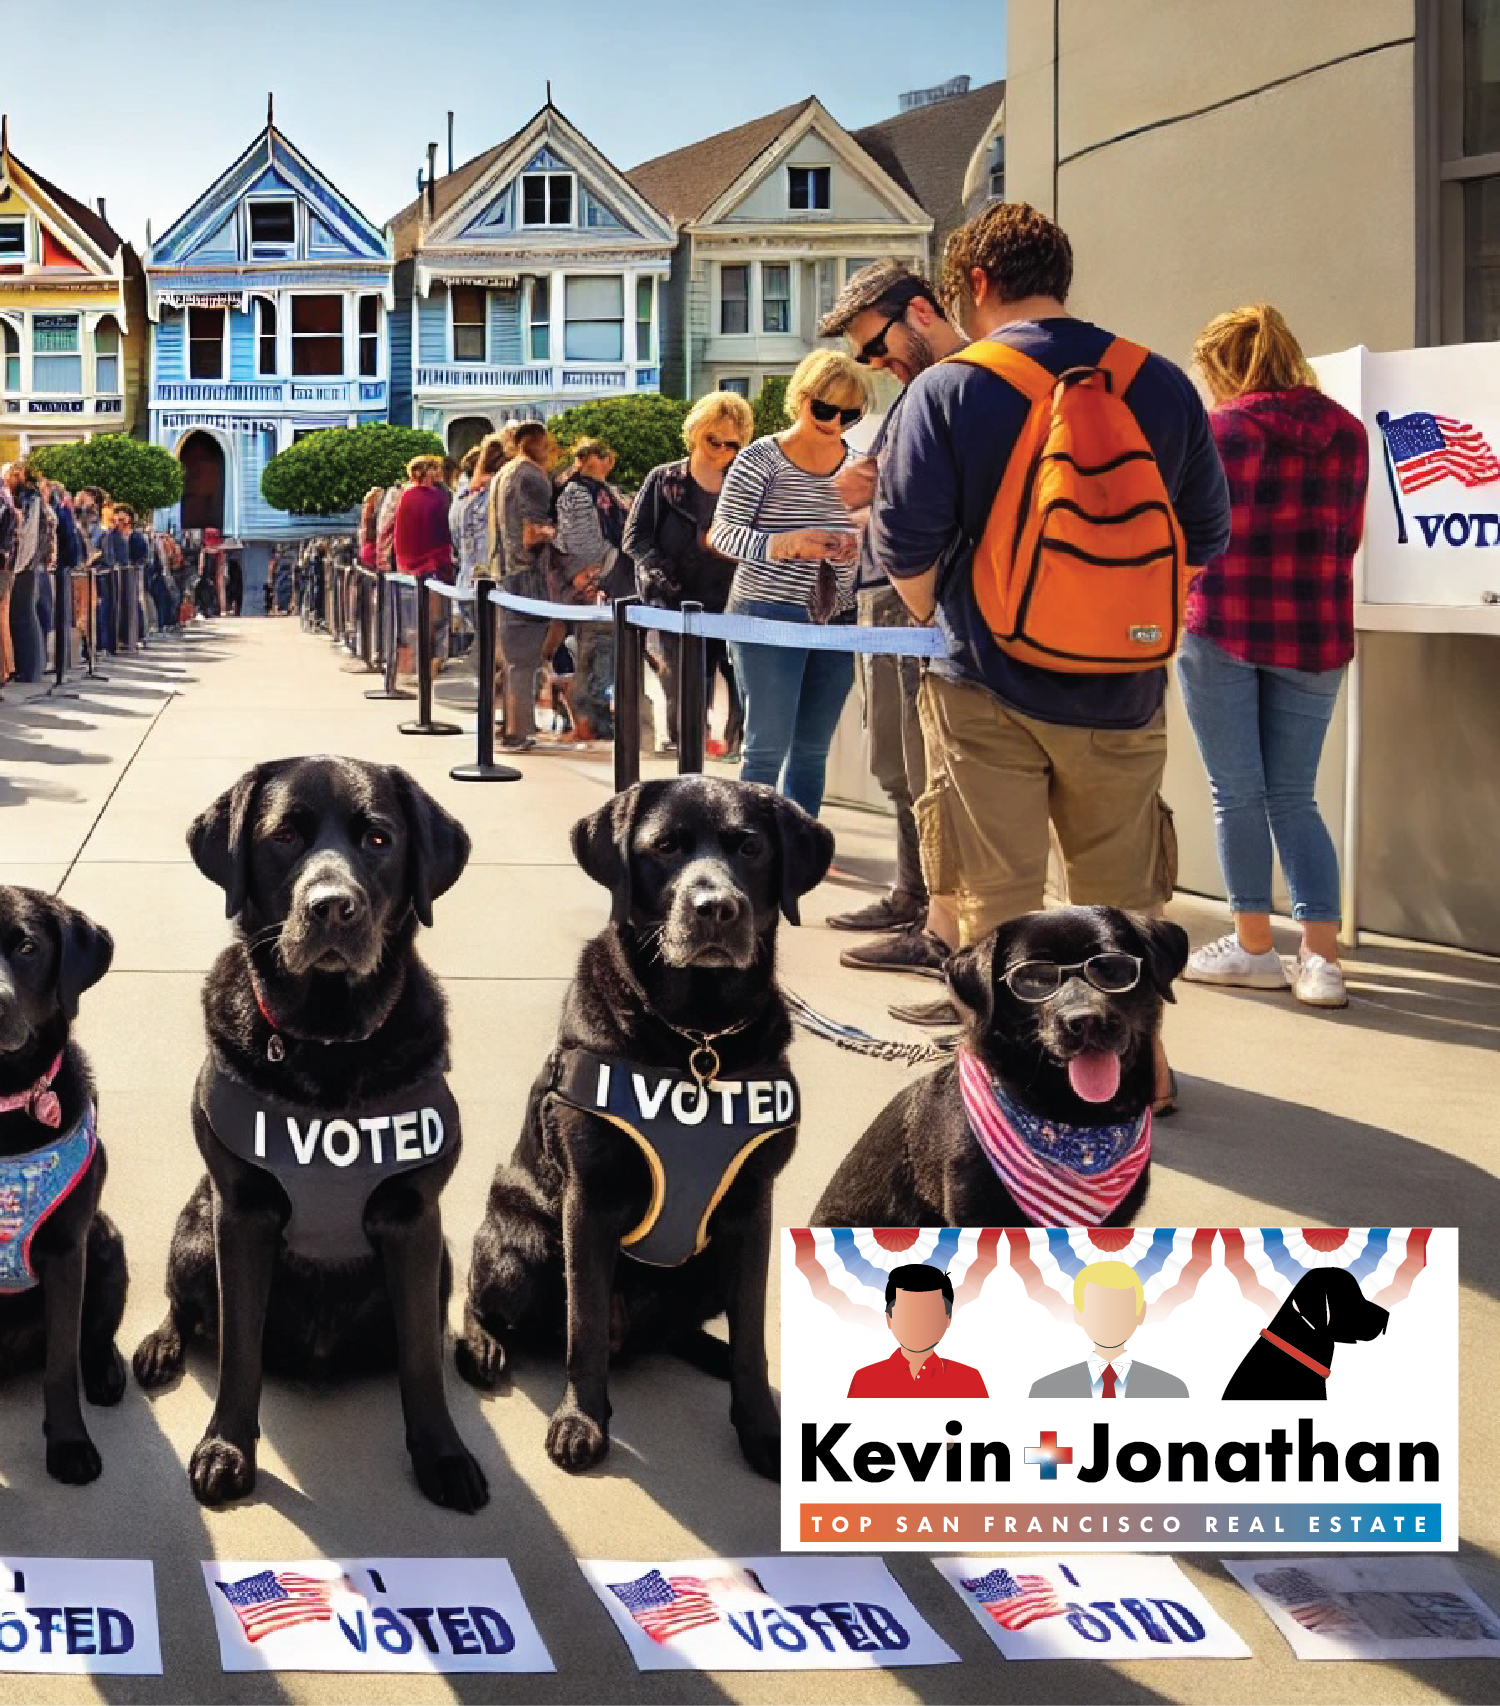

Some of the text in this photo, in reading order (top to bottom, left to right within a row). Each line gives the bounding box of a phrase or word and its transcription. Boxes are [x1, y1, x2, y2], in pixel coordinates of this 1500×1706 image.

[1413, 513, 1500, 548] VOT
[596, 1063, 794, 1125] I VOTED
[254, 1107, 445, 1167] I VOTED
[336, 1606, 516, 1655] VOTED
